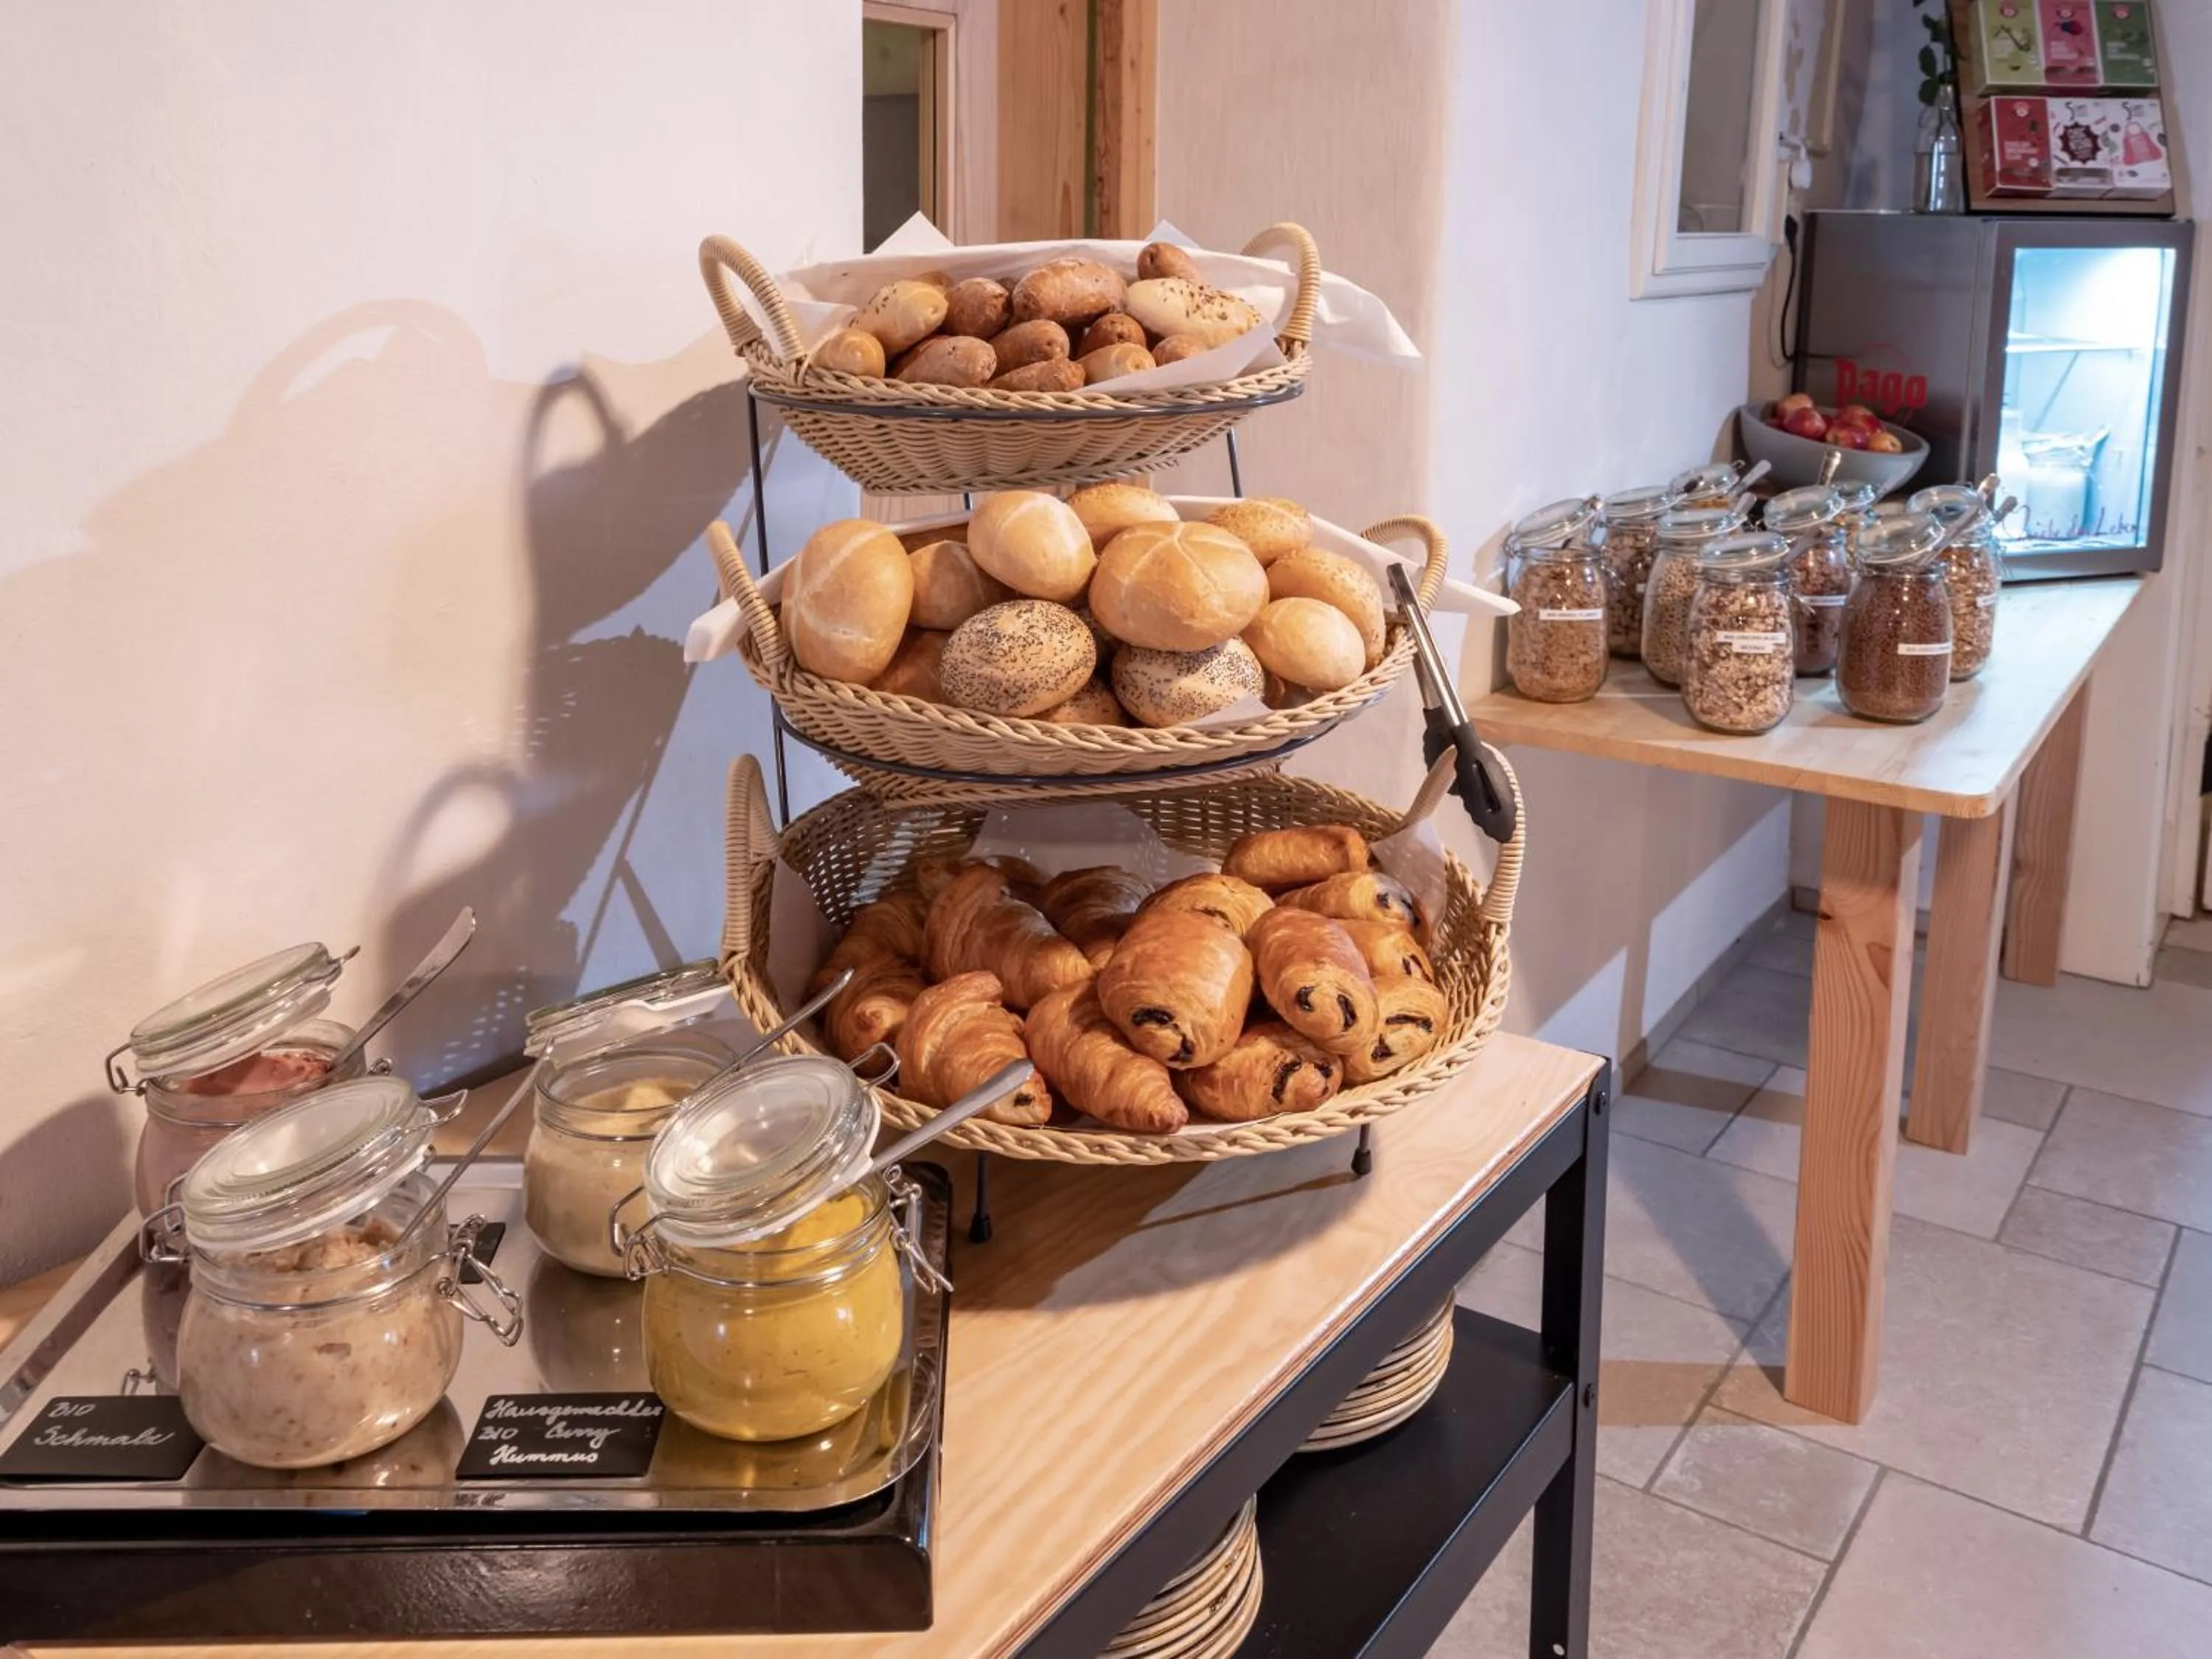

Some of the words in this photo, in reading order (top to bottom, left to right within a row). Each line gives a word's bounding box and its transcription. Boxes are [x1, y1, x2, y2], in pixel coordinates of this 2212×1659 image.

[48, 1401, 96, 1418] BIO
[478, 1426, 518, 1440] BIO
[543, 1421, 622, 1449] Curry
[489, 1444, 599, 1466] Hummus
